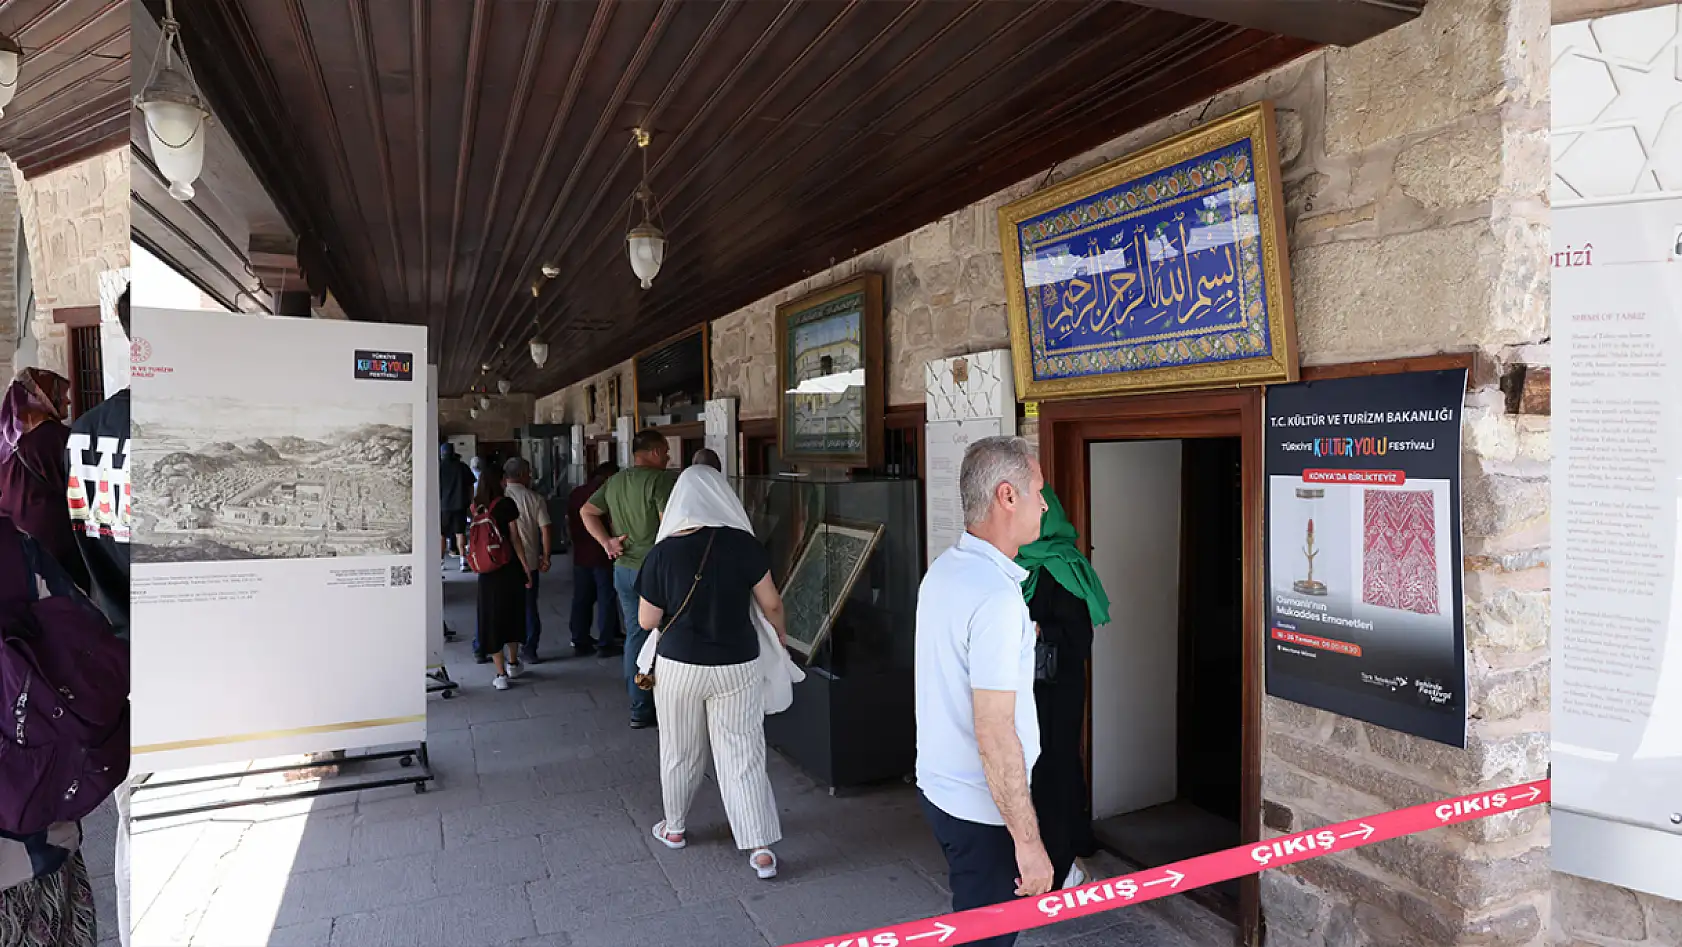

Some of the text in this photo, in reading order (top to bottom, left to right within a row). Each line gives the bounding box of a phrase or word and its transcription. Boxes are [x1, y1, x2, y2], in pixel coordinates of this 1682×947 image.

[1551, 242, 1594, 268] rizî
[387, 360, 410, 373] YOLU
[1270, 406, 1454, 427] T.C. KÜLTÜR VE TURİZM BAKANLIĞI
[1281, 436, 1436, 458] TÜRKİYE KÜLTÜR YOLU FESTİVALİ
[1308, 471, 1398, 483] KONYA'DA BİRLİKTEYİZ
[1275, 605, 1373, 631] Mukaddes Emanetleri
[1435, 793, 1508, 822] ÇIKIŞ
[1251, 830, 1336, 866] ÇIKIŞ
[1037, 878, 1138, 917] ÇIKIŞ
